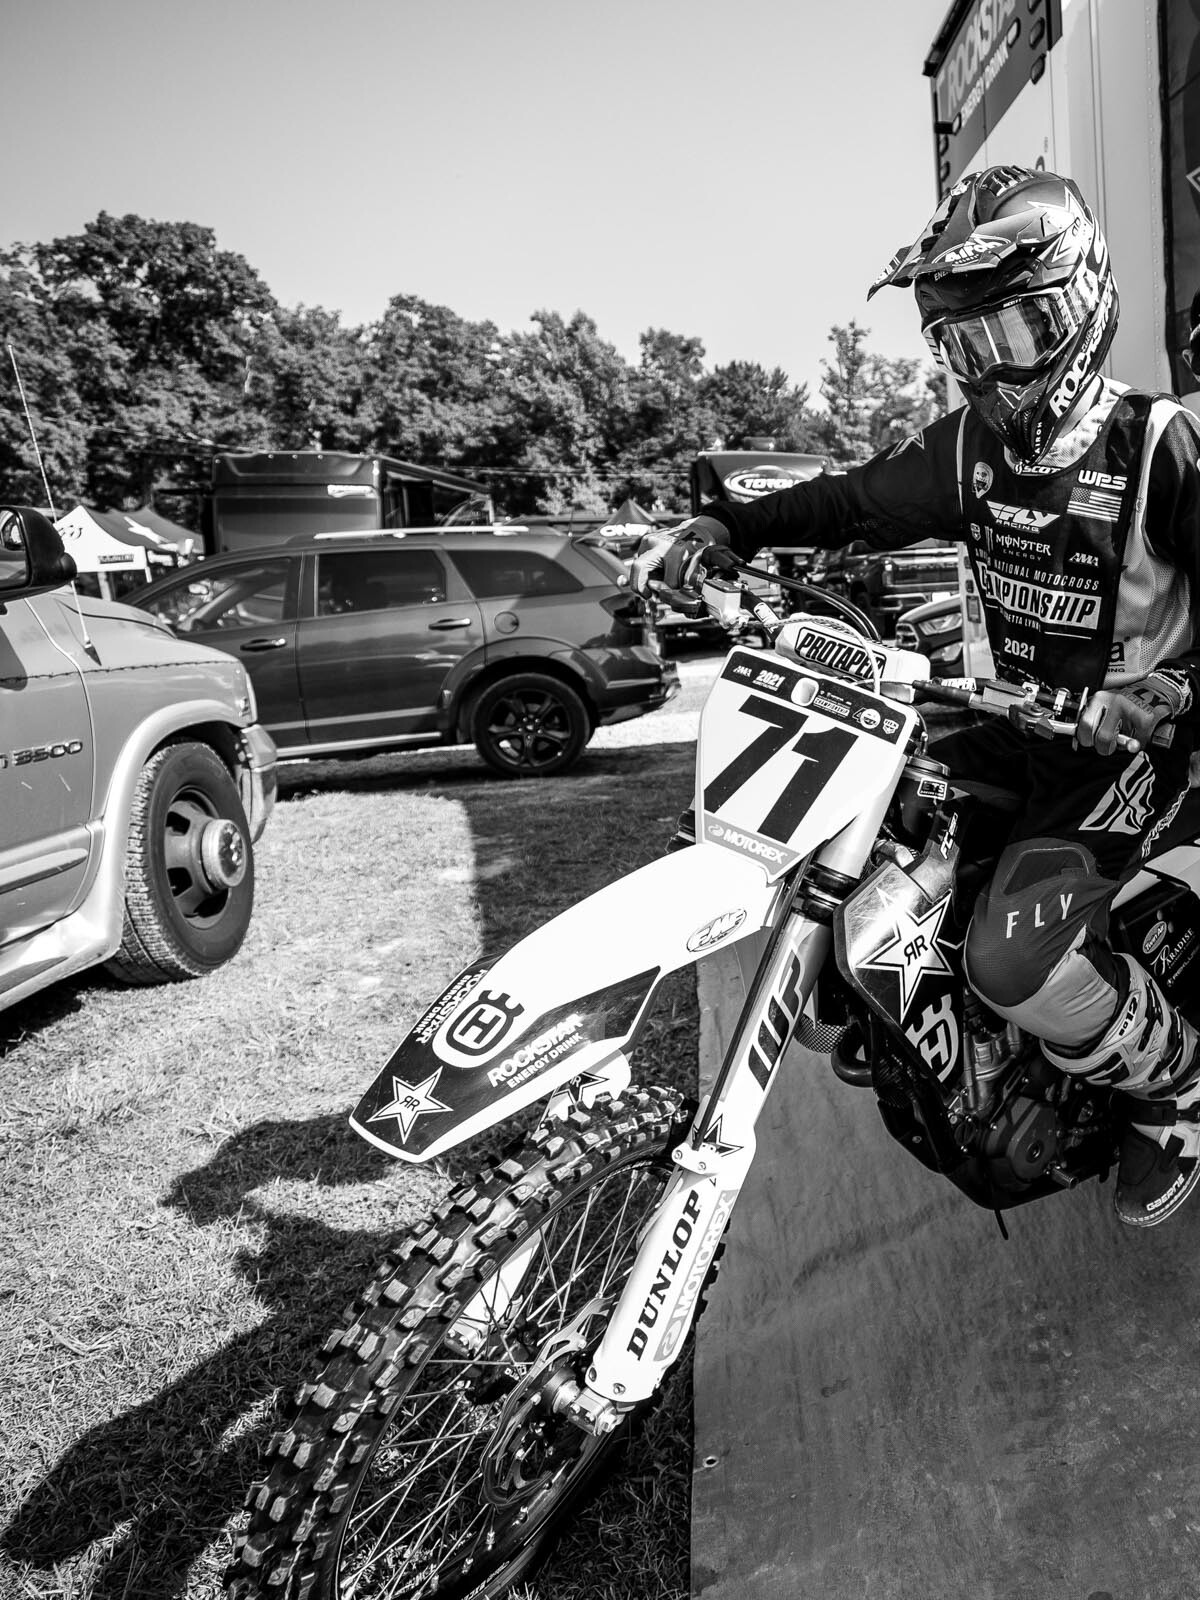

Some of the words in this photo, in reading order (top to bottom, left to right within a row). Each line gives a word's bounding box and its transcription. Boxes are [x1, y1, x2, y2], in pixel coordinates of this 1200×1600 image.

[1077, 469, 1128, 491] WPS
[986, 500, 1061, 528] FLY
[995, 519, 1041, 534] RACING
[1002, 549, 1042, 562] ENERGY
[1068, 552, 1099, 567] AMA
[1033, 569, 1100, 591] MOTOCROSS
[1004, 637, 1036, 662] 2021
[756, 670, 786, 688] 2021
[13, 739, 84, 767] 3500
[703, 693, 860, 845] 71
[723, 828, 788, 865] MOTOREX
[1006, 893, 1073, 939] FLY
[486, 1013, 584, 1087] ROCKSTAR
[507, 1056, 550, 1088] ENERGY
[548, 1032, 584, 1060] DRINK
[626, 1189, 702, 1361] DUNLOP
